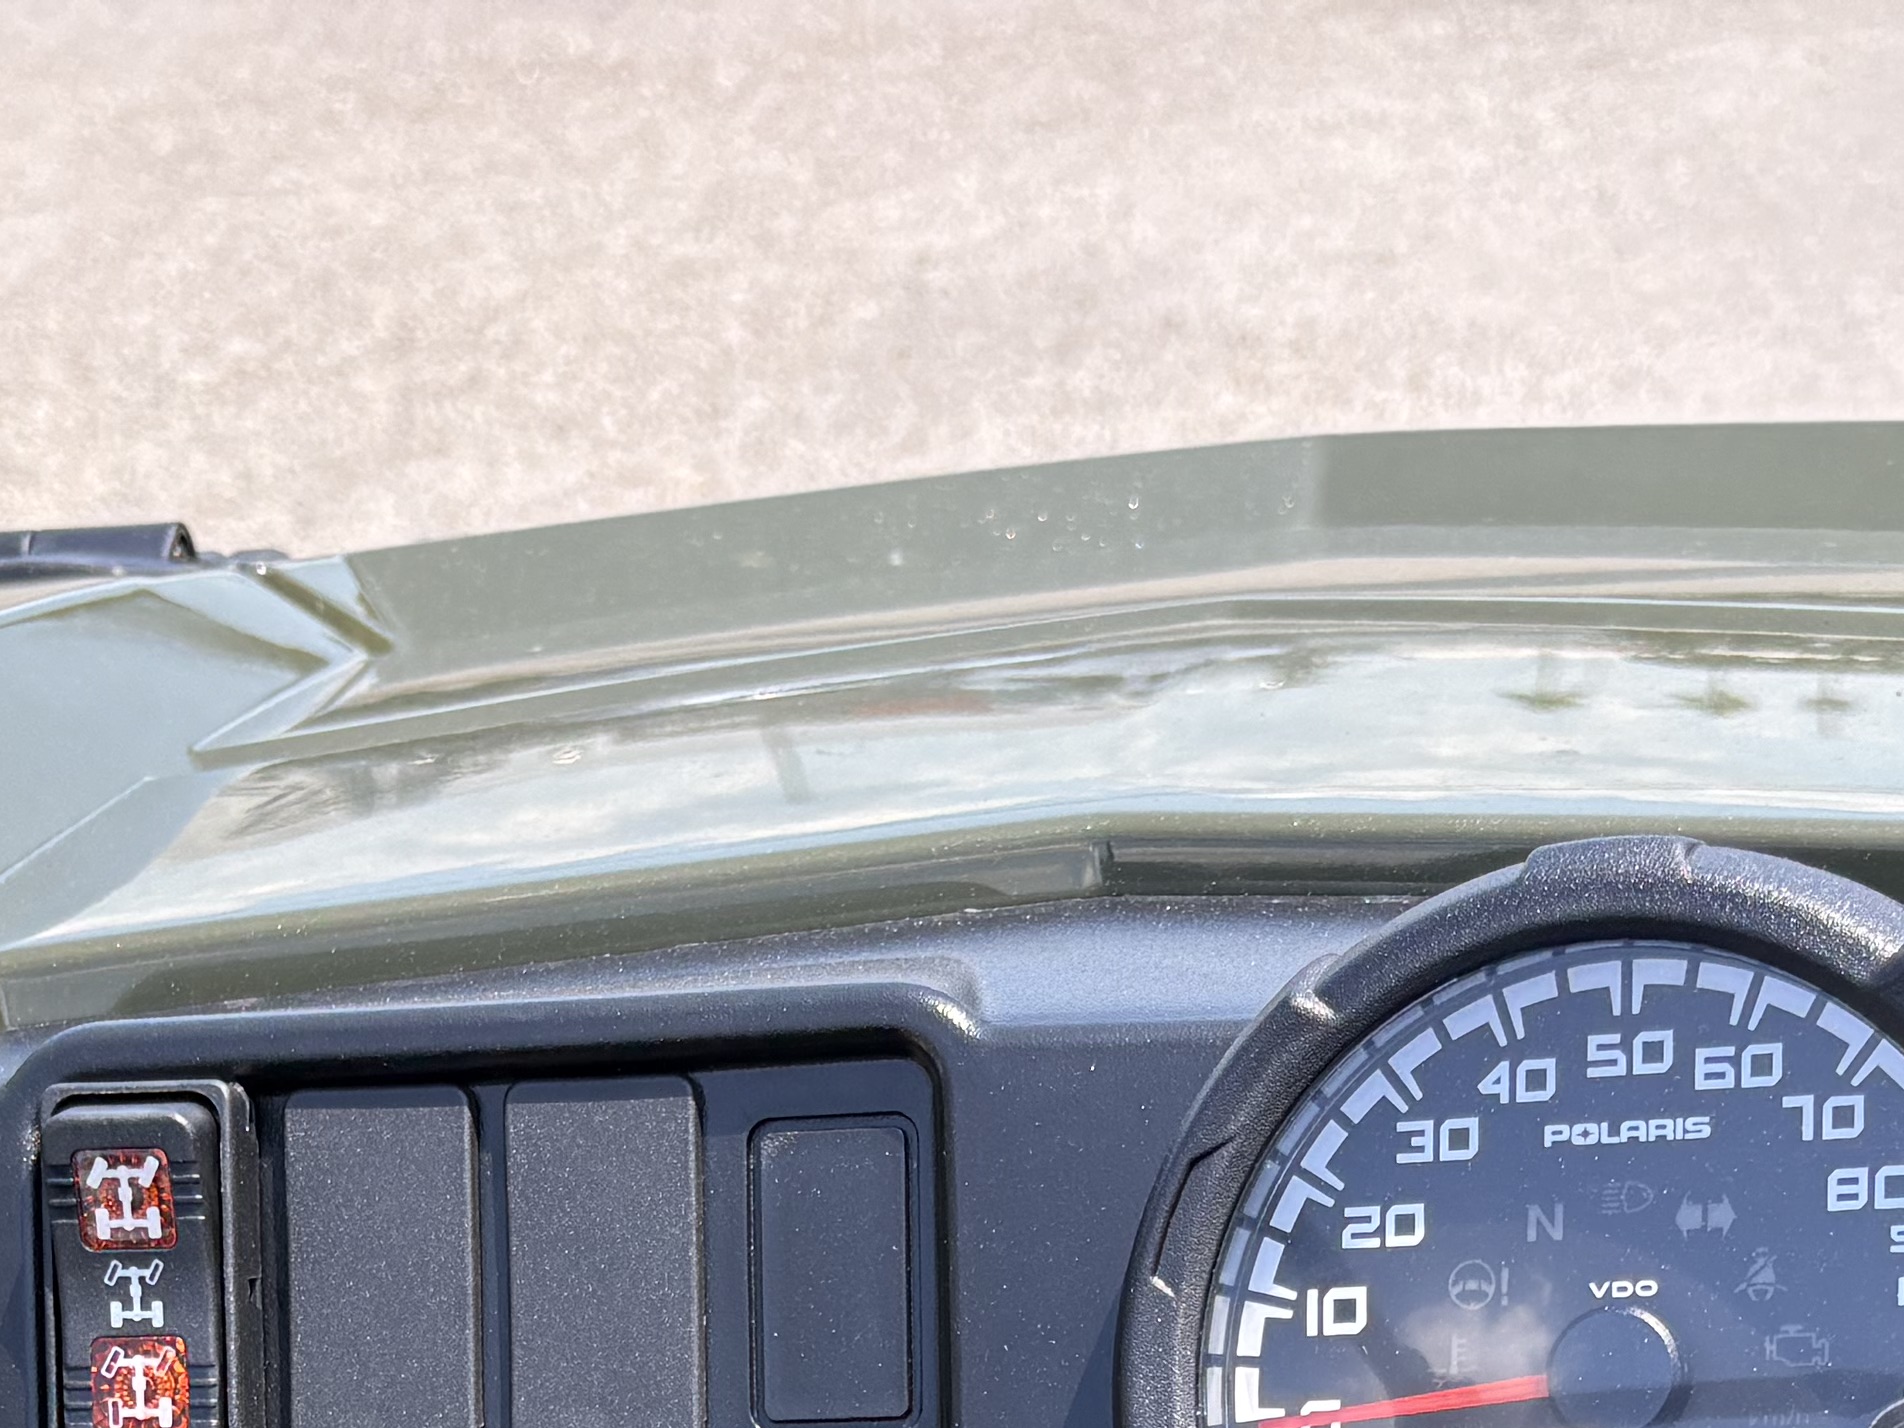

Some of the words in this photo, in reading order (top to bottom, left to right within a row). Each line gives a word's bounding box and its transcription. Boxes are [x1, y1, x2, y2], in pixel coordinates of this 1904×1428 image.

[1587, 1030, 1673, 1078] 50
[1695, 1043, 1783, 1090] 60
[1477, 1058, 1556, 1103] 40
[1396, 1117, 1479, 1163] 30
[1544, 1117, 1711, 1147] POLARIS
[1782, 1094, 1864, 1141] 70
[1342, 1203, 1425, 1249] 20
[1306, 1286, 1367, 1336] 10
[1589, 1280, 1658, 1299] VDO
